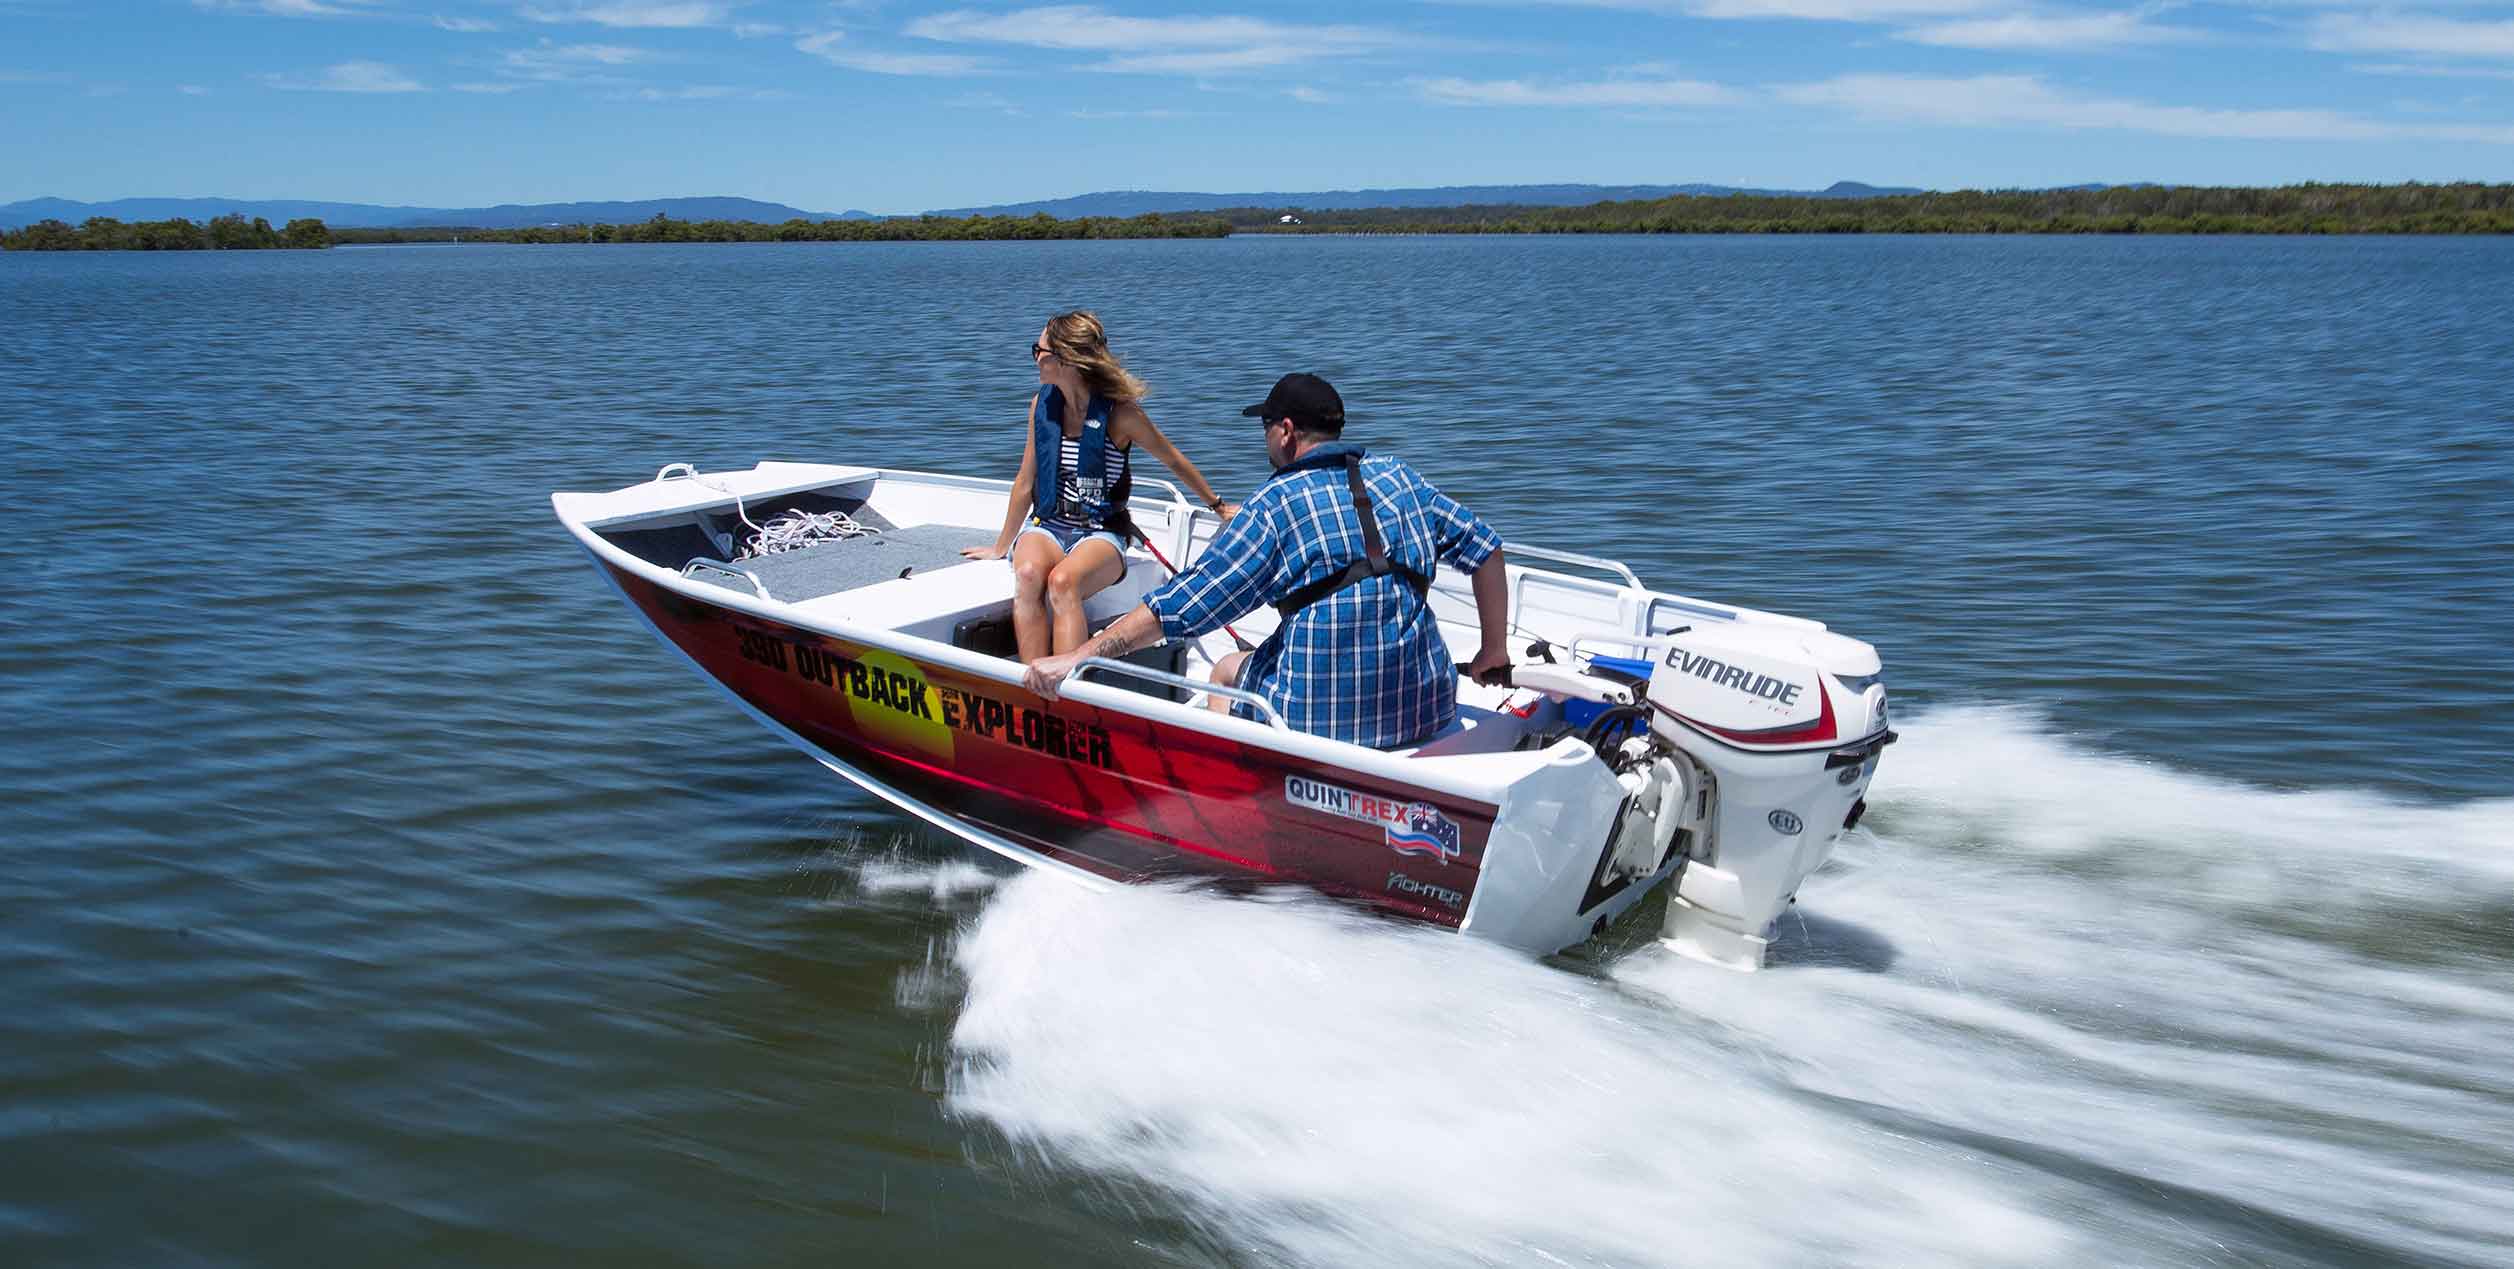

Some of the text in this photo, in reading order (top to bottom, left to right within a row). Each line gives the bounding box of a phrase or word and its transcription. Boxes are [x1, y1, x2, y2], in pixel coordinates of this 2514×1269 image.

[736, 625, 1112, 768] 390 OUTBACK EXPLORER
[1665, 646, 1803, 706] EVINRUDE
[1289, 778, 1409, 825] QUINTREX
[1385, 871, 1463, 911] FIGHTER
